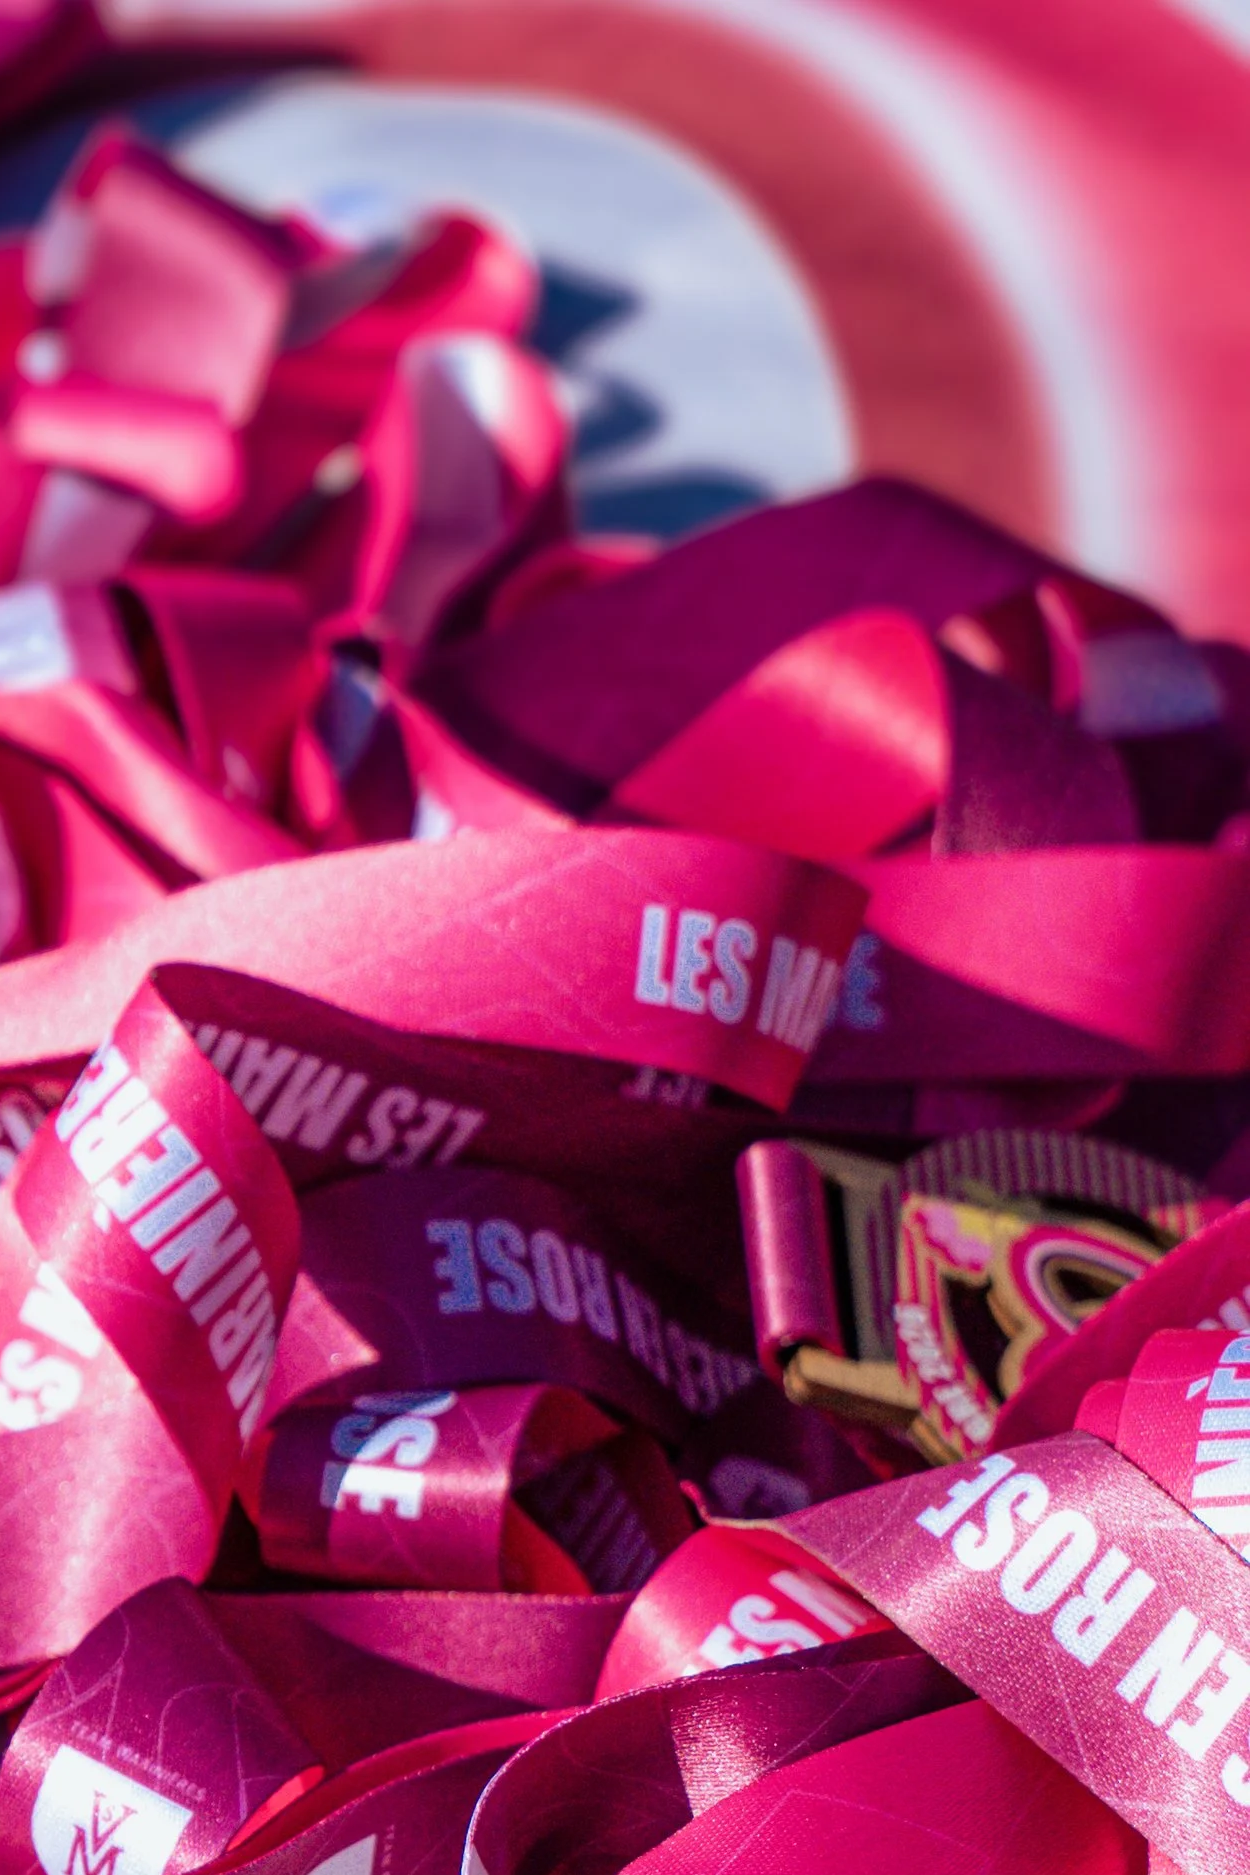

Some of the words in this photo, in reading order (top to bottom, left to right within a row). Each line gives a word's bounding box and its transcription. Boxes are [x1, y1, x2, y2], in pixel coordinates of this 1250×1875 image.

[635, 903, 758, 1024] LES
[425, 1218, 619, 1344] ROSE
[915, 1453, 1157, 1668] ROSE
